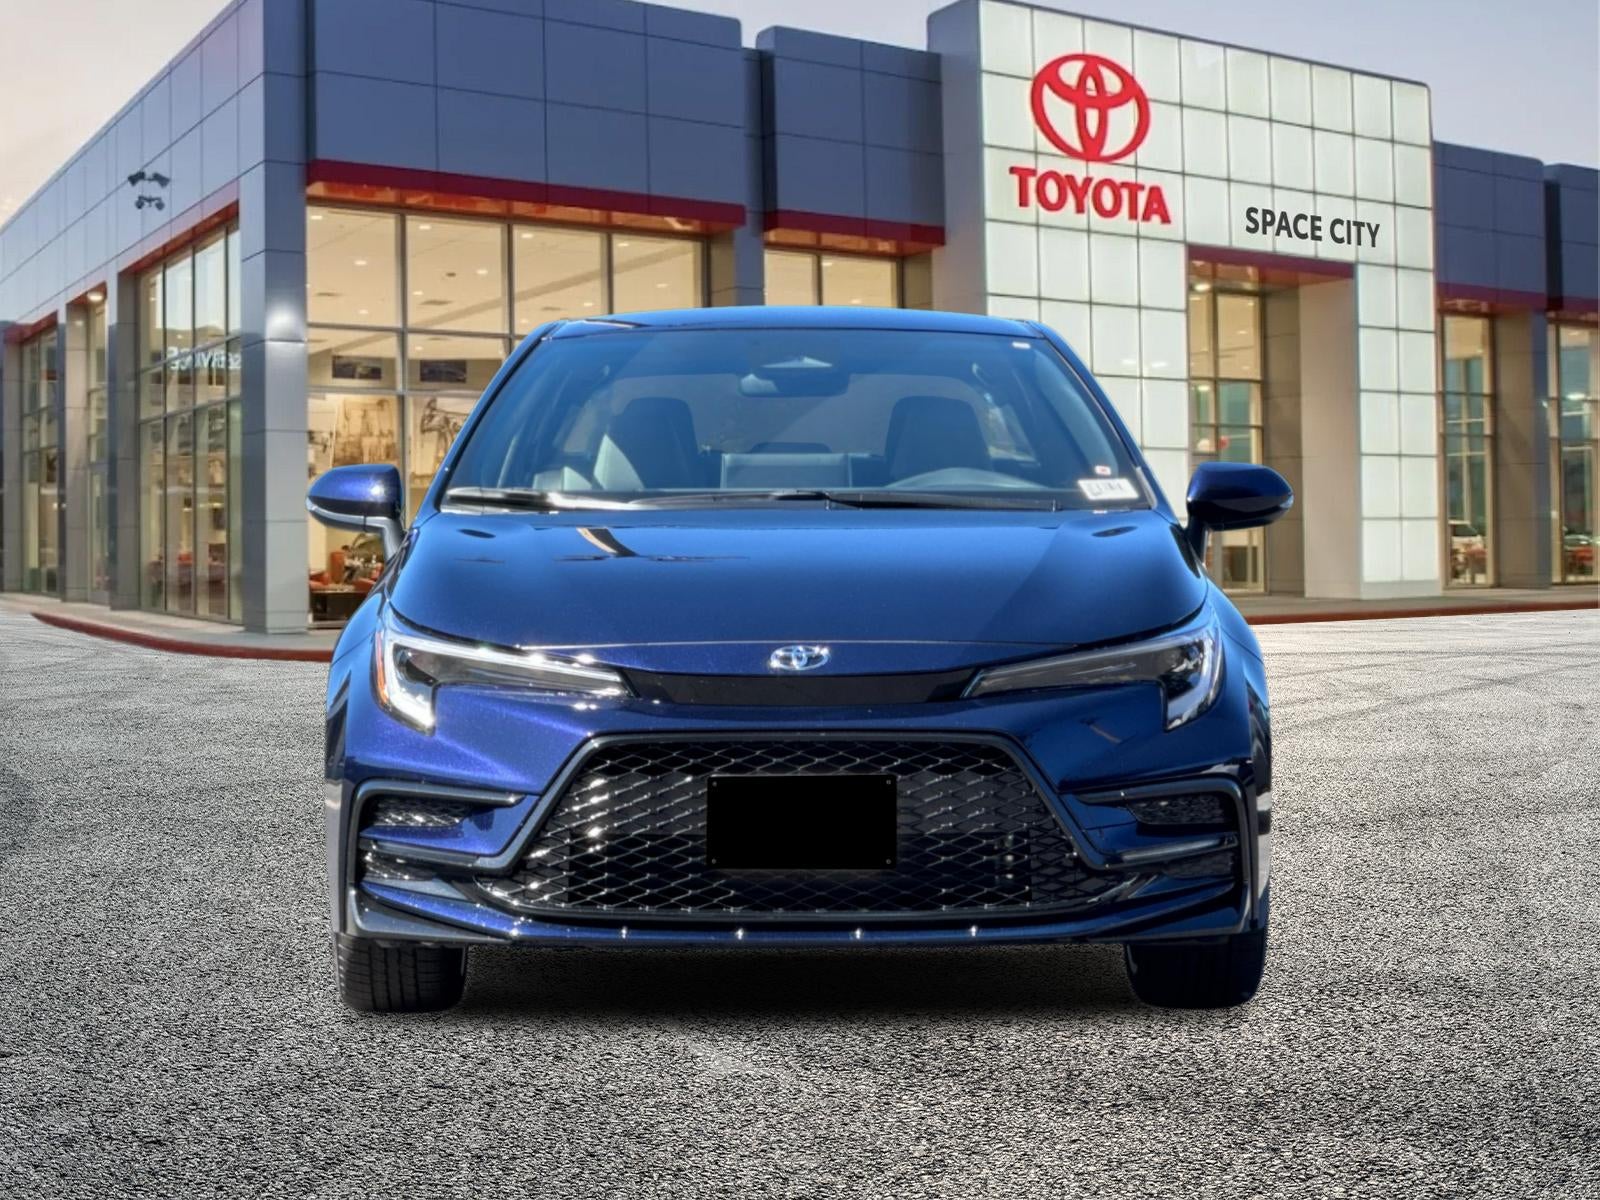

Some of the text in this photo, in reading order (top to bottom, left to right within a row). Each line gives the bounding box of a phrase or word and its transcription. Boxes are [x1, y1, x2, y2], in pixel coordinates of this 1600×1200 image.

[1009, 166, 1171, 225] TOYOTA
[1245, 206, 1381, 248] SPACE CITY
